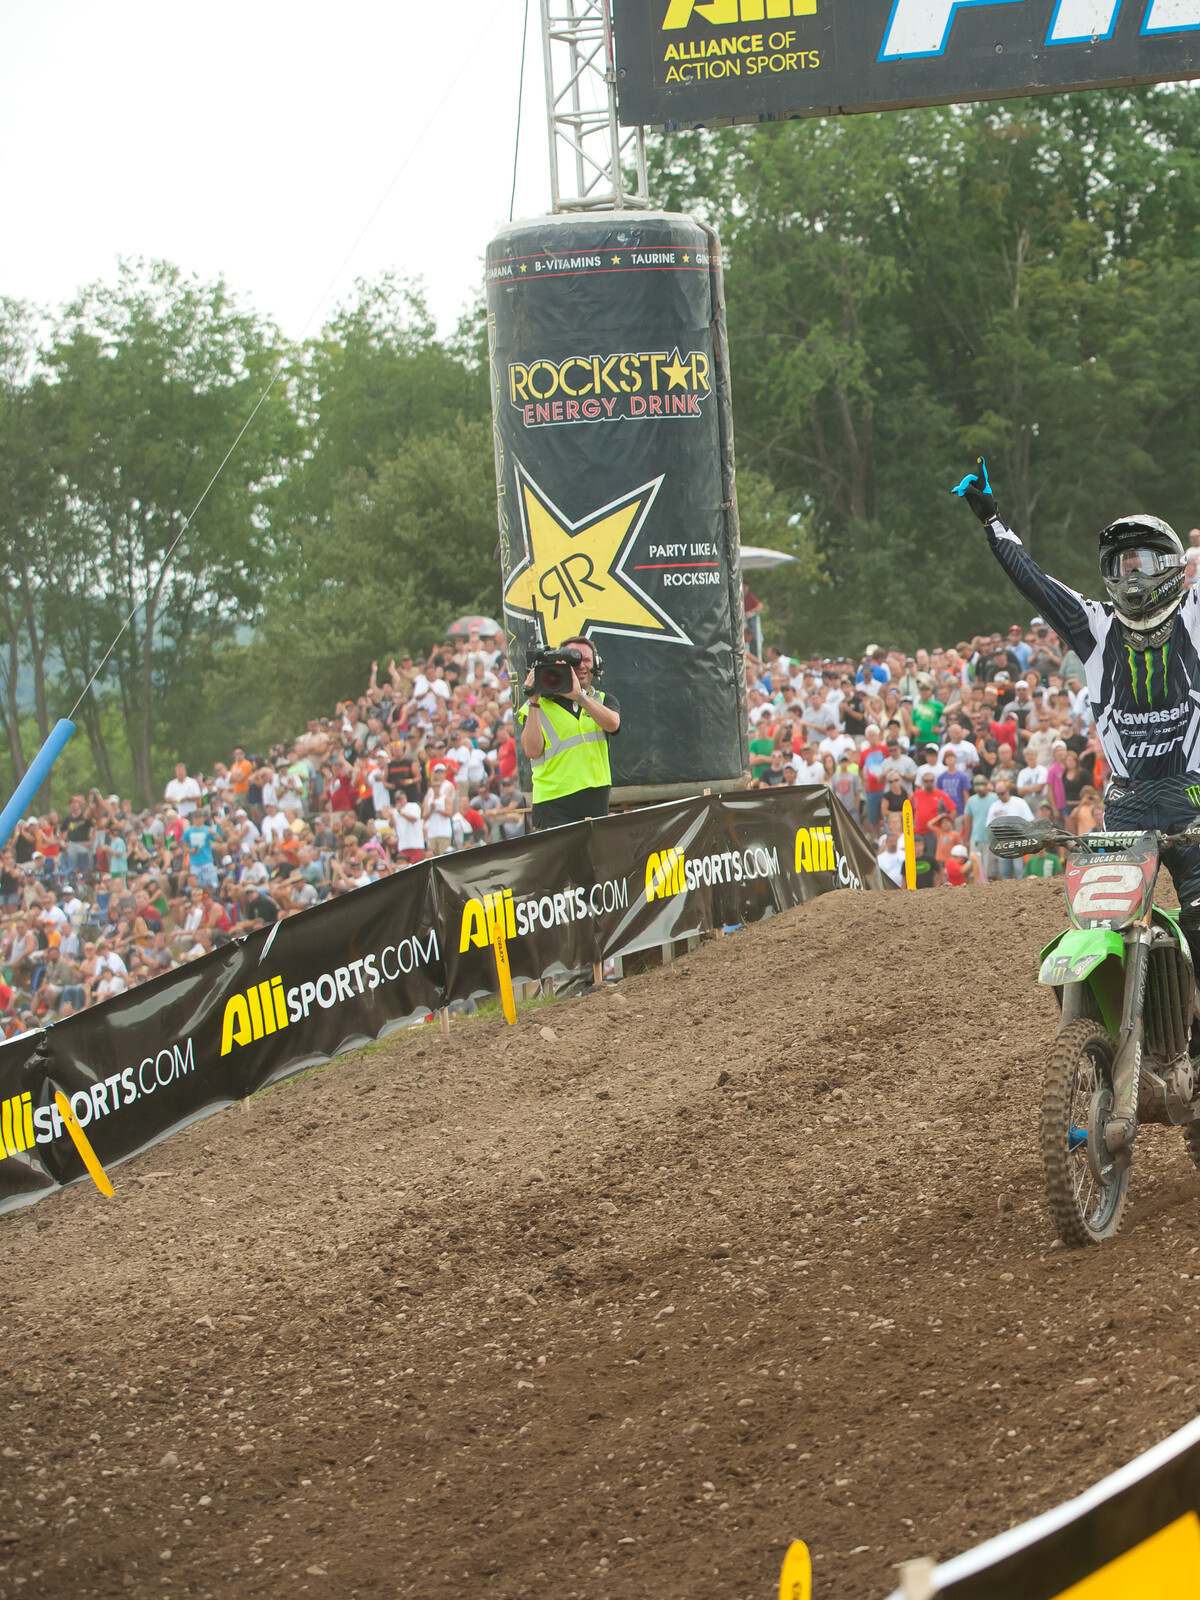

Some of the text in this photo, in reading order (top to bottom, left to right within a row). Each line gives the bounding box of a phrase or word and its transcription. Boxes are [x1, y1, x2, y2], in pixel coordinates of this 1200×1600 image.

[664, 30, 797, 62] ALLIANCE OF
[665, 50, 820, 84] ACTION SPORTS
[535, 255, 601, 272] B-VITAMINS
[631, 253, 675, 265] TAURINE
[525, 394, 699, 424] ENERGY DRINK
[649, 542, 718, 558] PARTY LIKE A
[664, 573, 720, 587] ROCKSTAR
[1127, 736, 1184, 758] thor
[995, 838, 1039, 850] ACERBIS
[1090, 855, 1114, 864] LUCAS
[1072, 865, 1143, 914] 2
